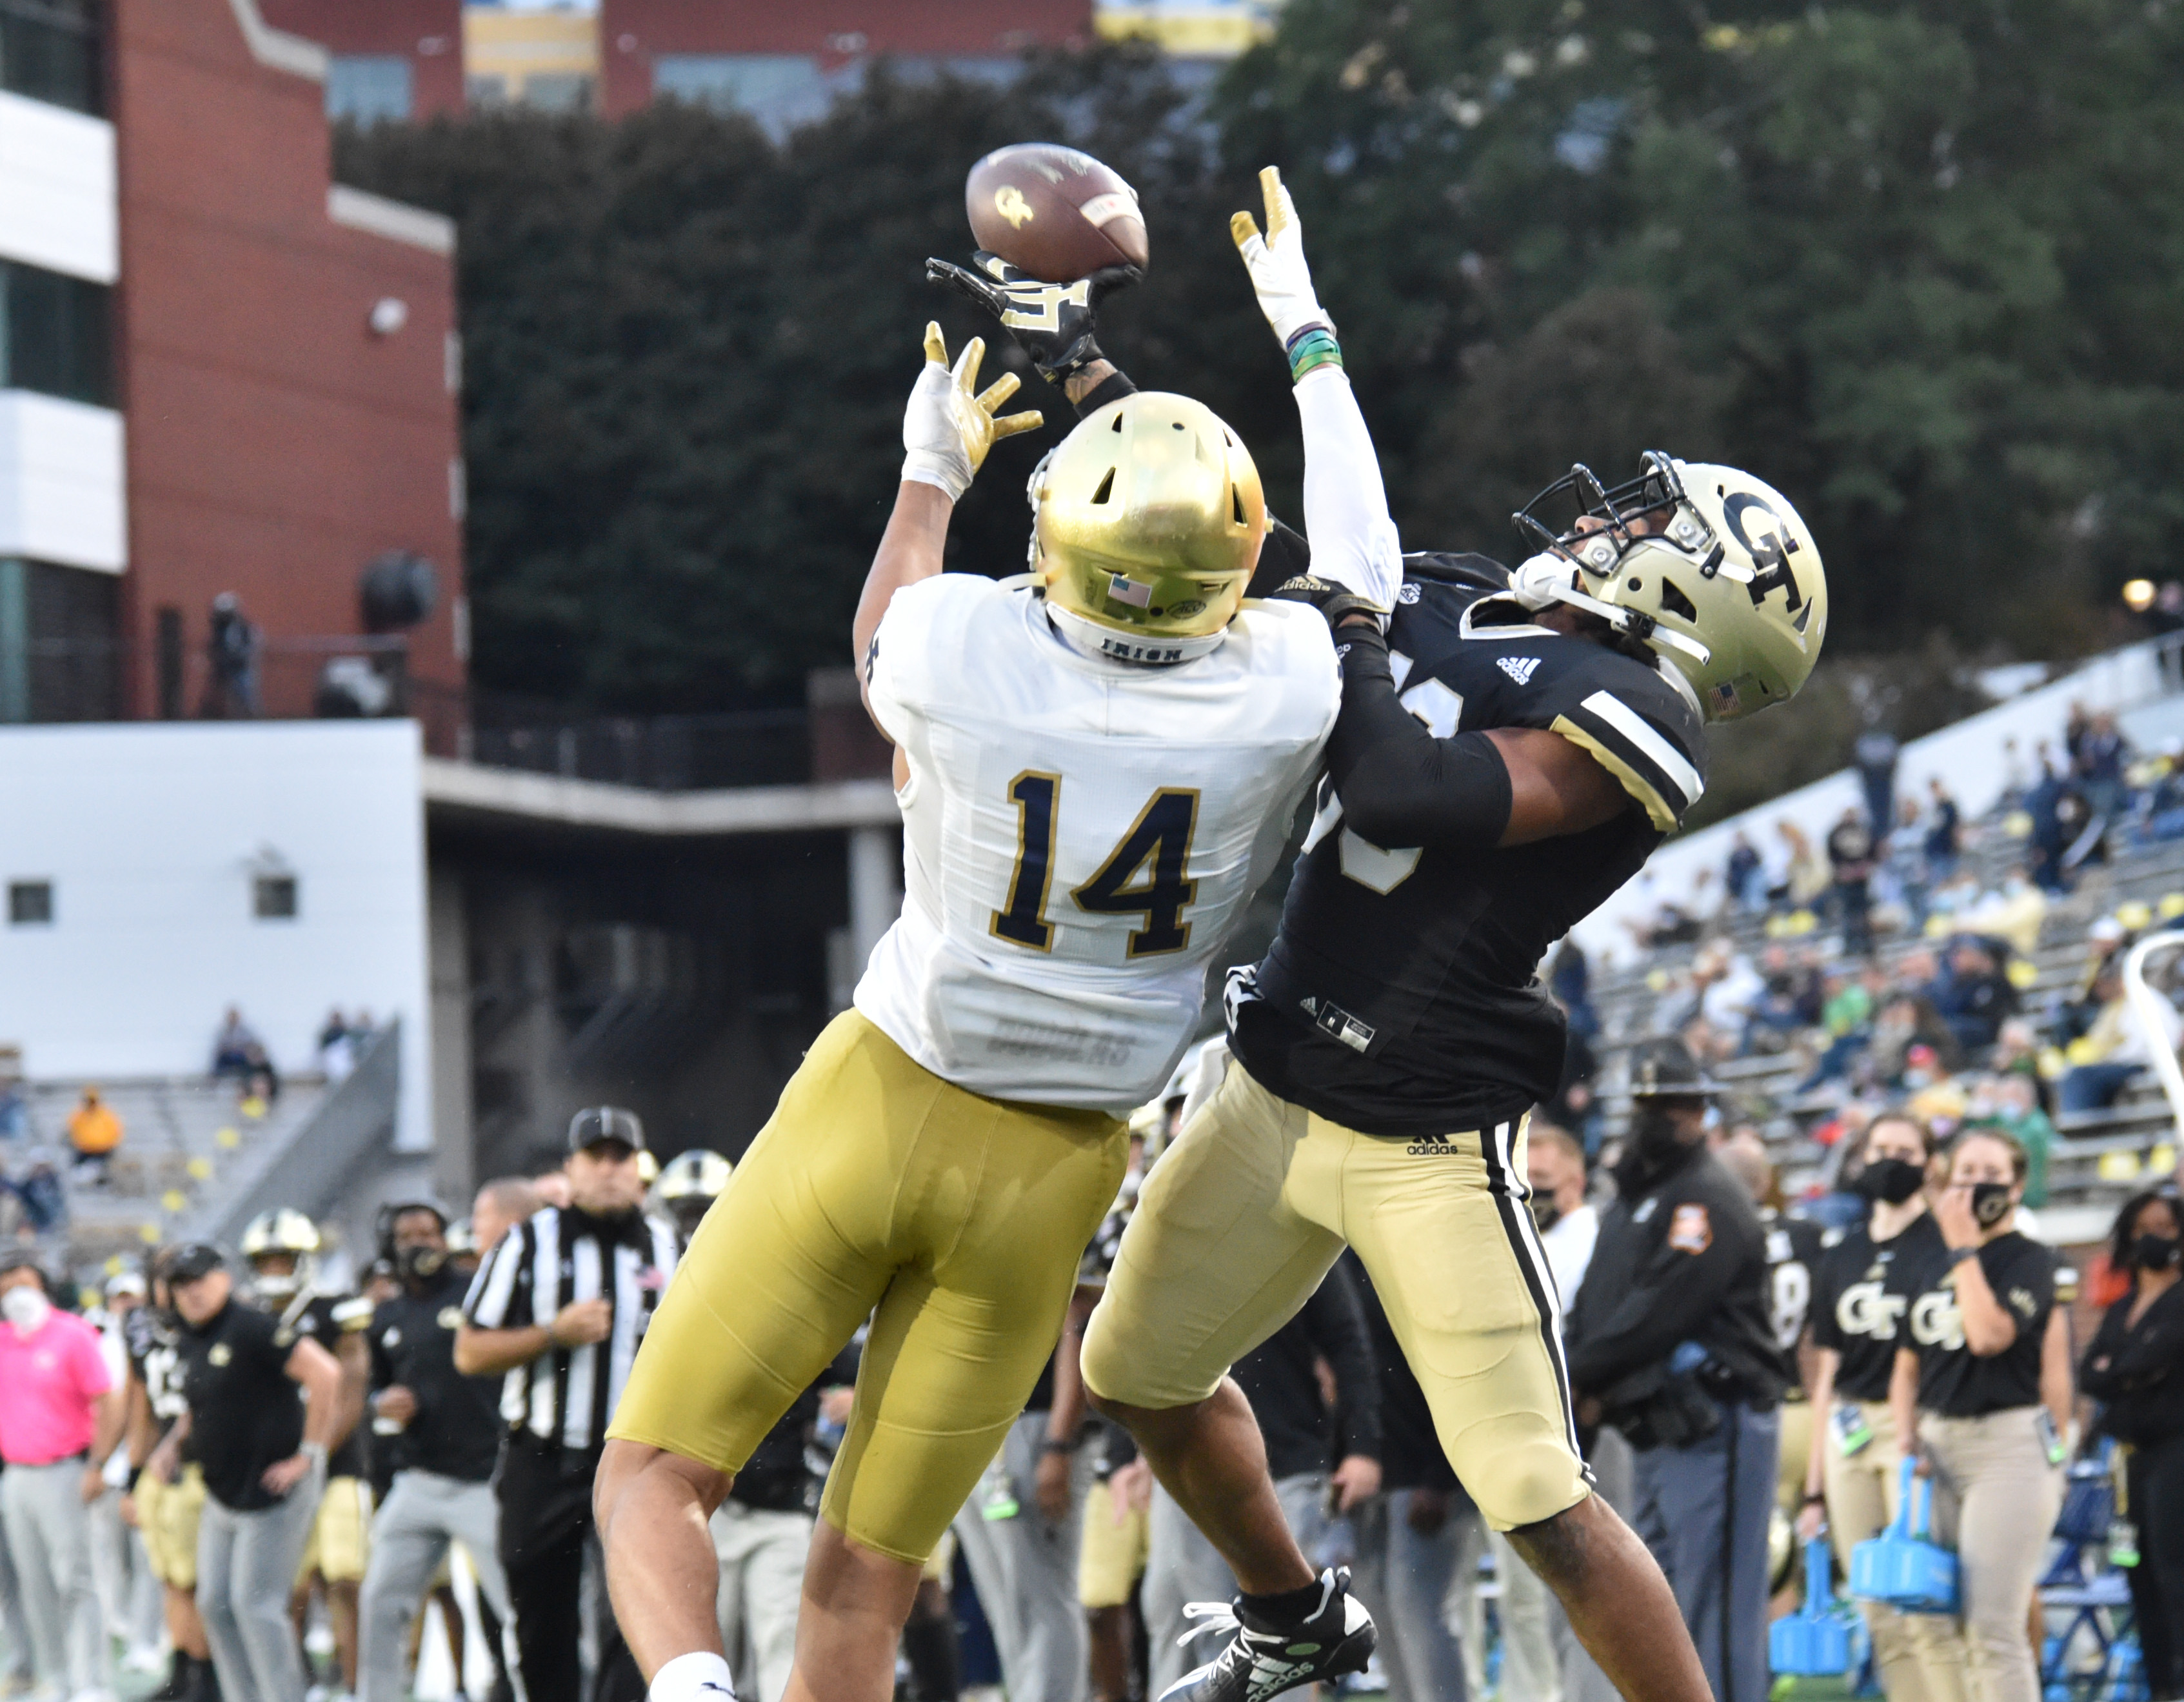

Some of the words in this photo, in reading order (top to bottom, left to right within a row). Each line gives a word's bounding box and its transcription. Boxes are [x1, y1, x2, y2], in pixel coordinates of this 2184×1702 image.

[1723, 492, 1802, 614] GT
[1400, 586, 1415, 602] ACC
[1101, 637, 1182, 661] IRISH
[1496, 657, 1529, 685] adidas
[989, 768, 1200, 959] 14
[1407, 1143, 1458, 1155] adidas
[1836, 1282, 1907, 1341] GT
[1246, 1662, 1315, 1702] adidas
